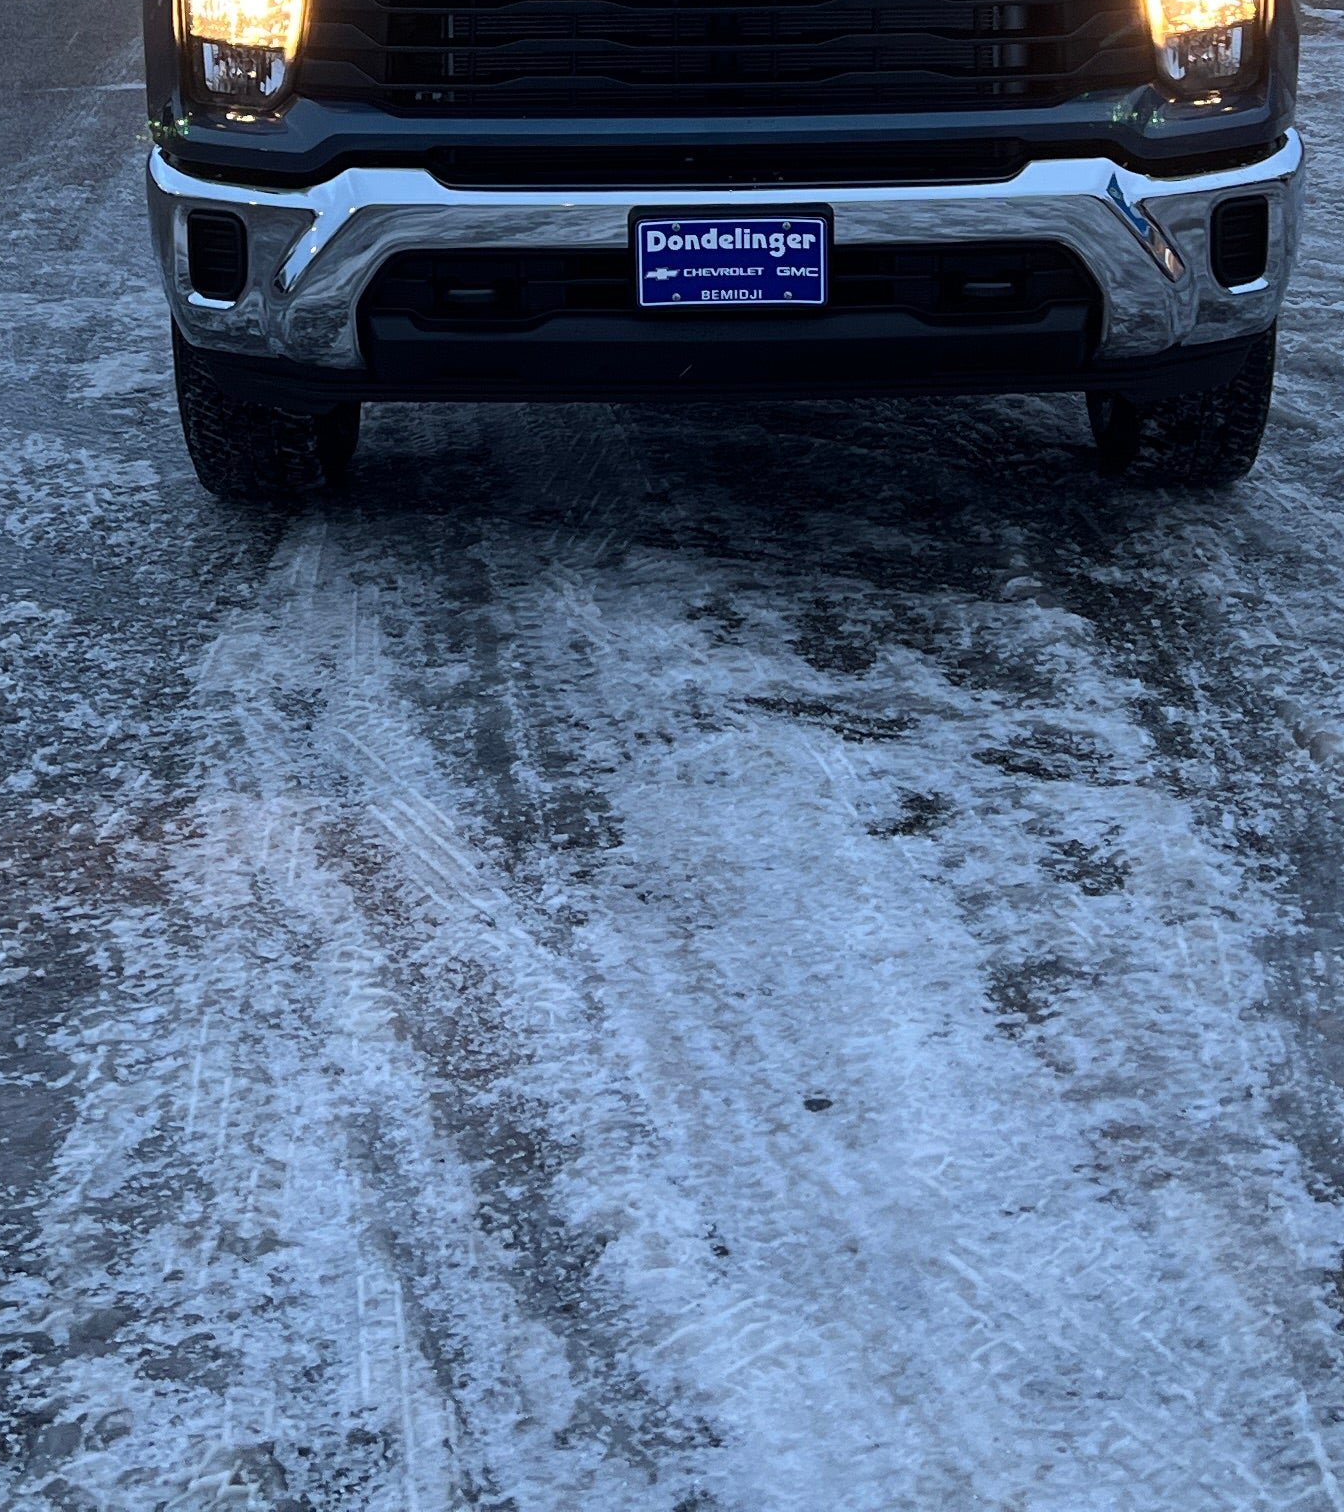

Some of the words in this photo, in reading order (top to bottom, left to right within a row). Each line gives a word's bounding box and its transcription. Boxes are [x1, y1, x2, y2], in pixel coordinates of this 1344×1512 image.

[646, 228, 816, 258] Dondelinger
[683, 267, 764, 277] CHEVROLET
[776, 266, 819, 277] GMC
[701, 289, 763, 301] BEMIDJI
